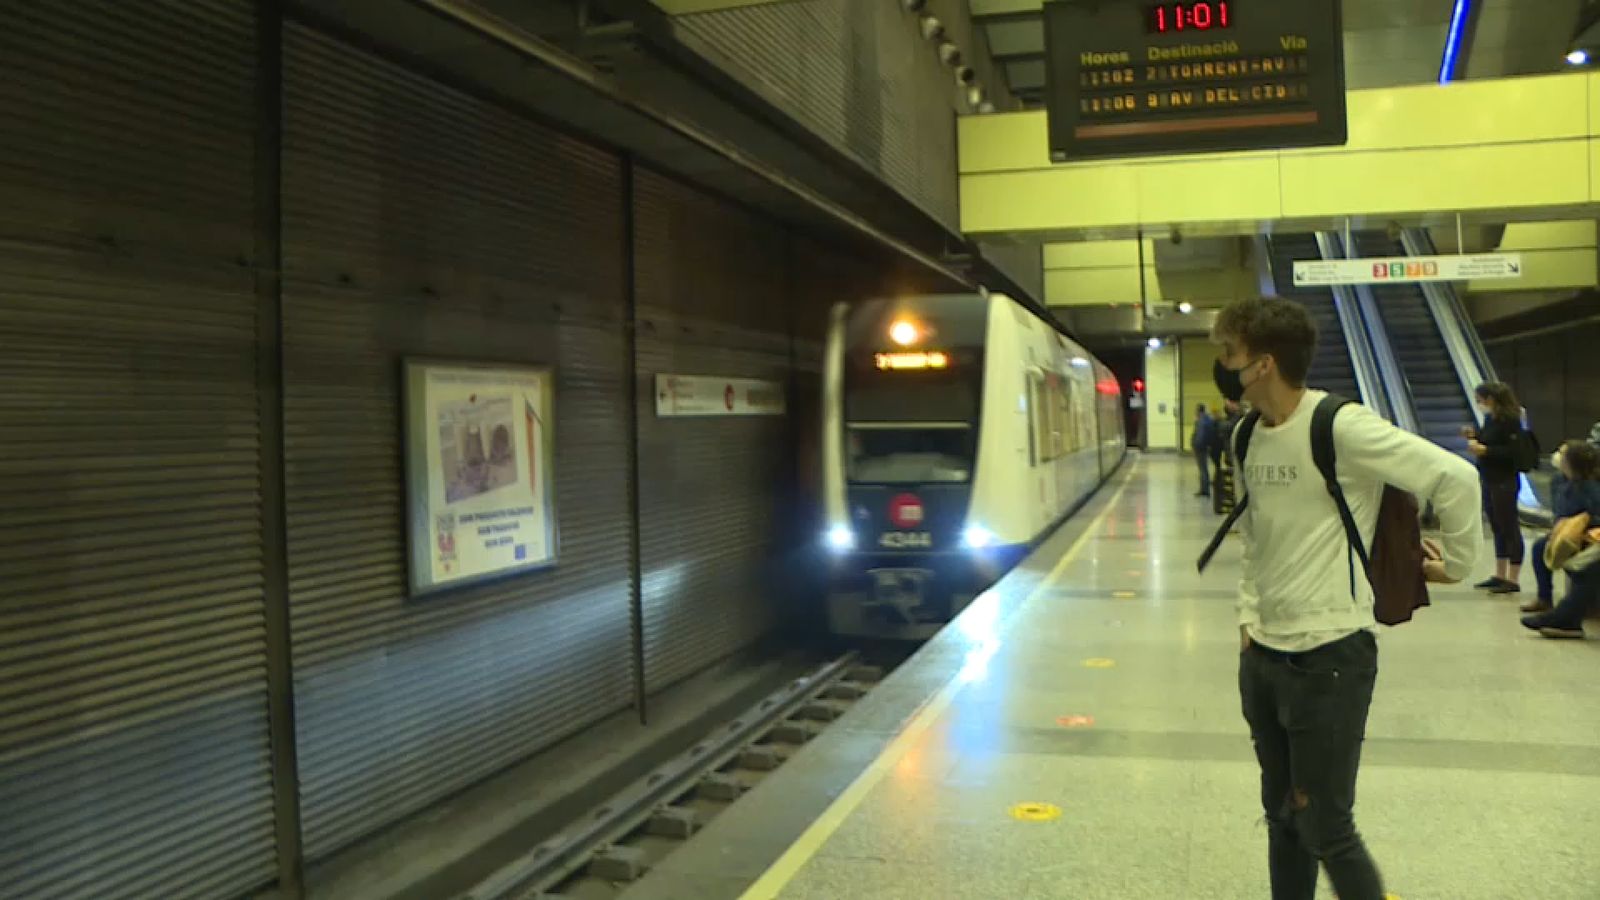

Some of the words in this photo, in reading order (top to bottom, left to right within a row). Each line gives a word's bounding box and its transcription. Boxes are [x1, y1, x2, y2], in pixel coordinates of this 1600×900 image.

[1156, 2, 1227, 32] 11:01
[1148, 40, 1239, 60] Destinació
[1280, 34, 1307, 50] Via
[1171, 91, 1192, 106] AV
[1206, 88, 1240, 103] DEL
